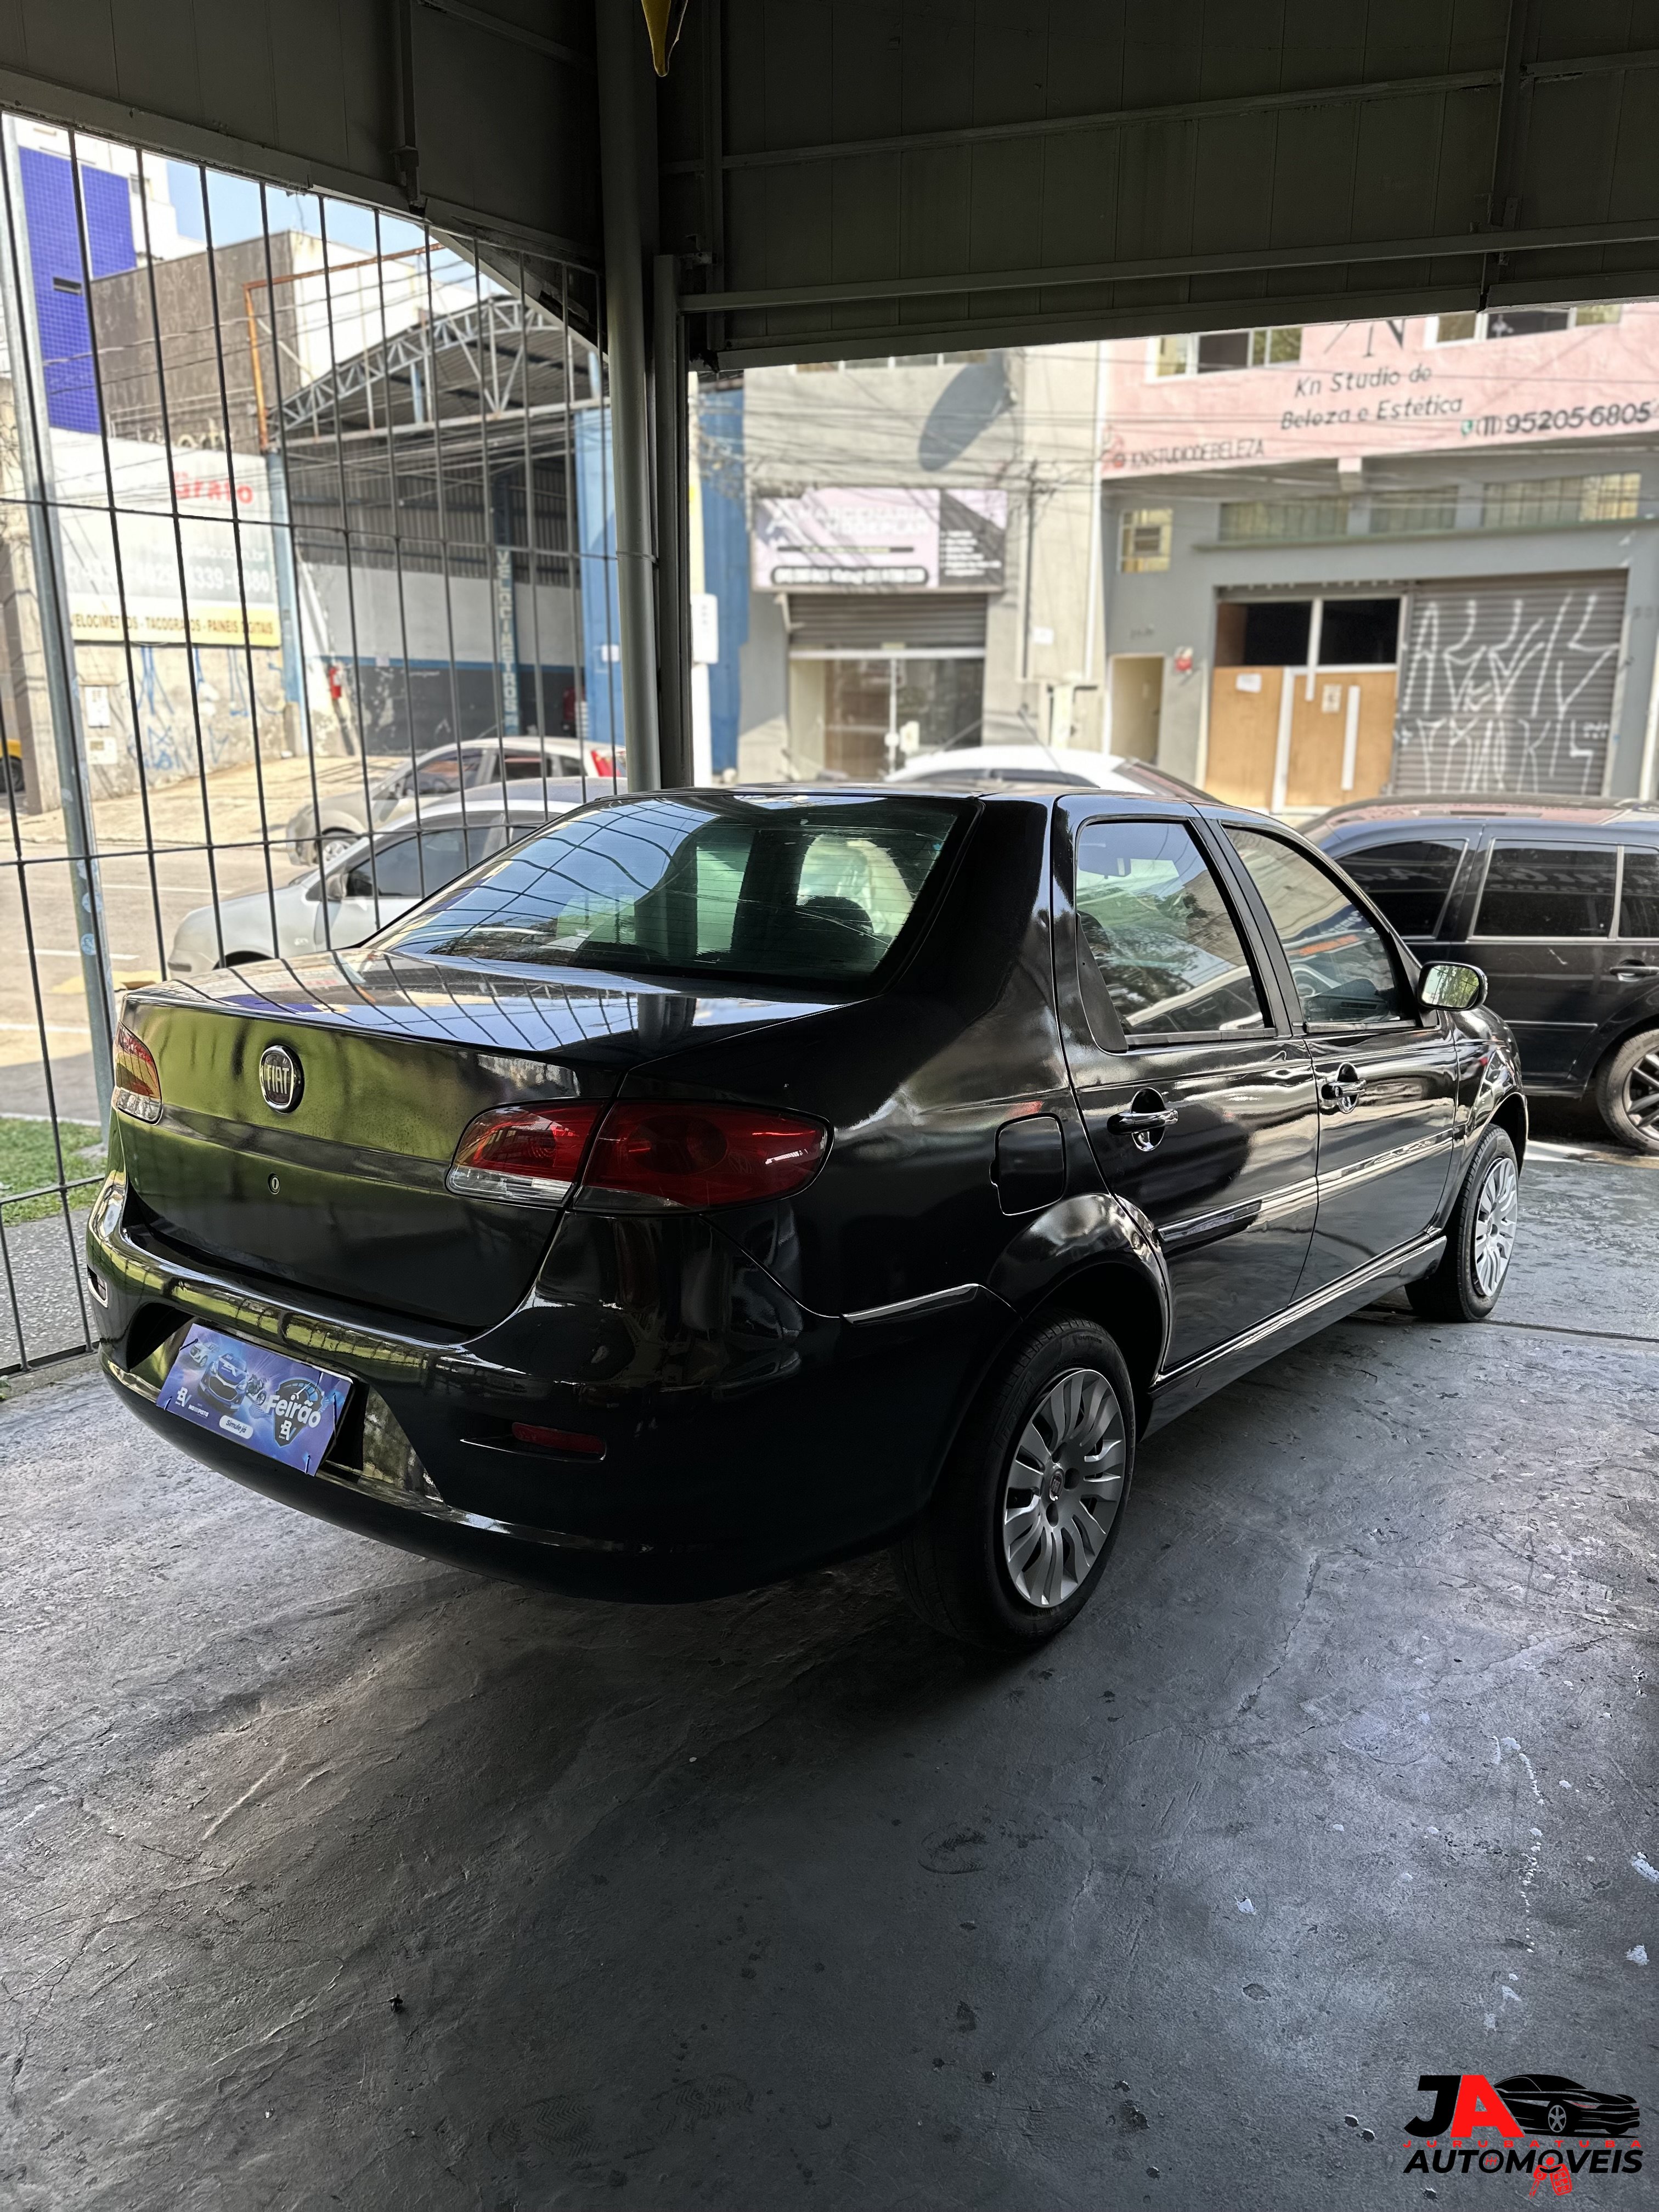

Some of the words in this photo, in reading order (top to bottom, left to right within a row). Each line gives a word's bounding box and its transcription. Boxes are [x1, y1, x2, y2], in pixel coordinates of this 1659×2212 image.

[1295, 376, 1322, 398] Kn
[1330, 366, 1401, 393] Studio
[1408, 363, 1432, 383] de
[1281, 409, 1350, 431] Beleza
[1357, 408, 1369, 422] e
[267, 1064, 289, 1094] FIAT
[225, 1419, 241, 1431] Simule
[240, 1424, 247, 1434] já
[266, 1395, 321, 1428] Feirão
